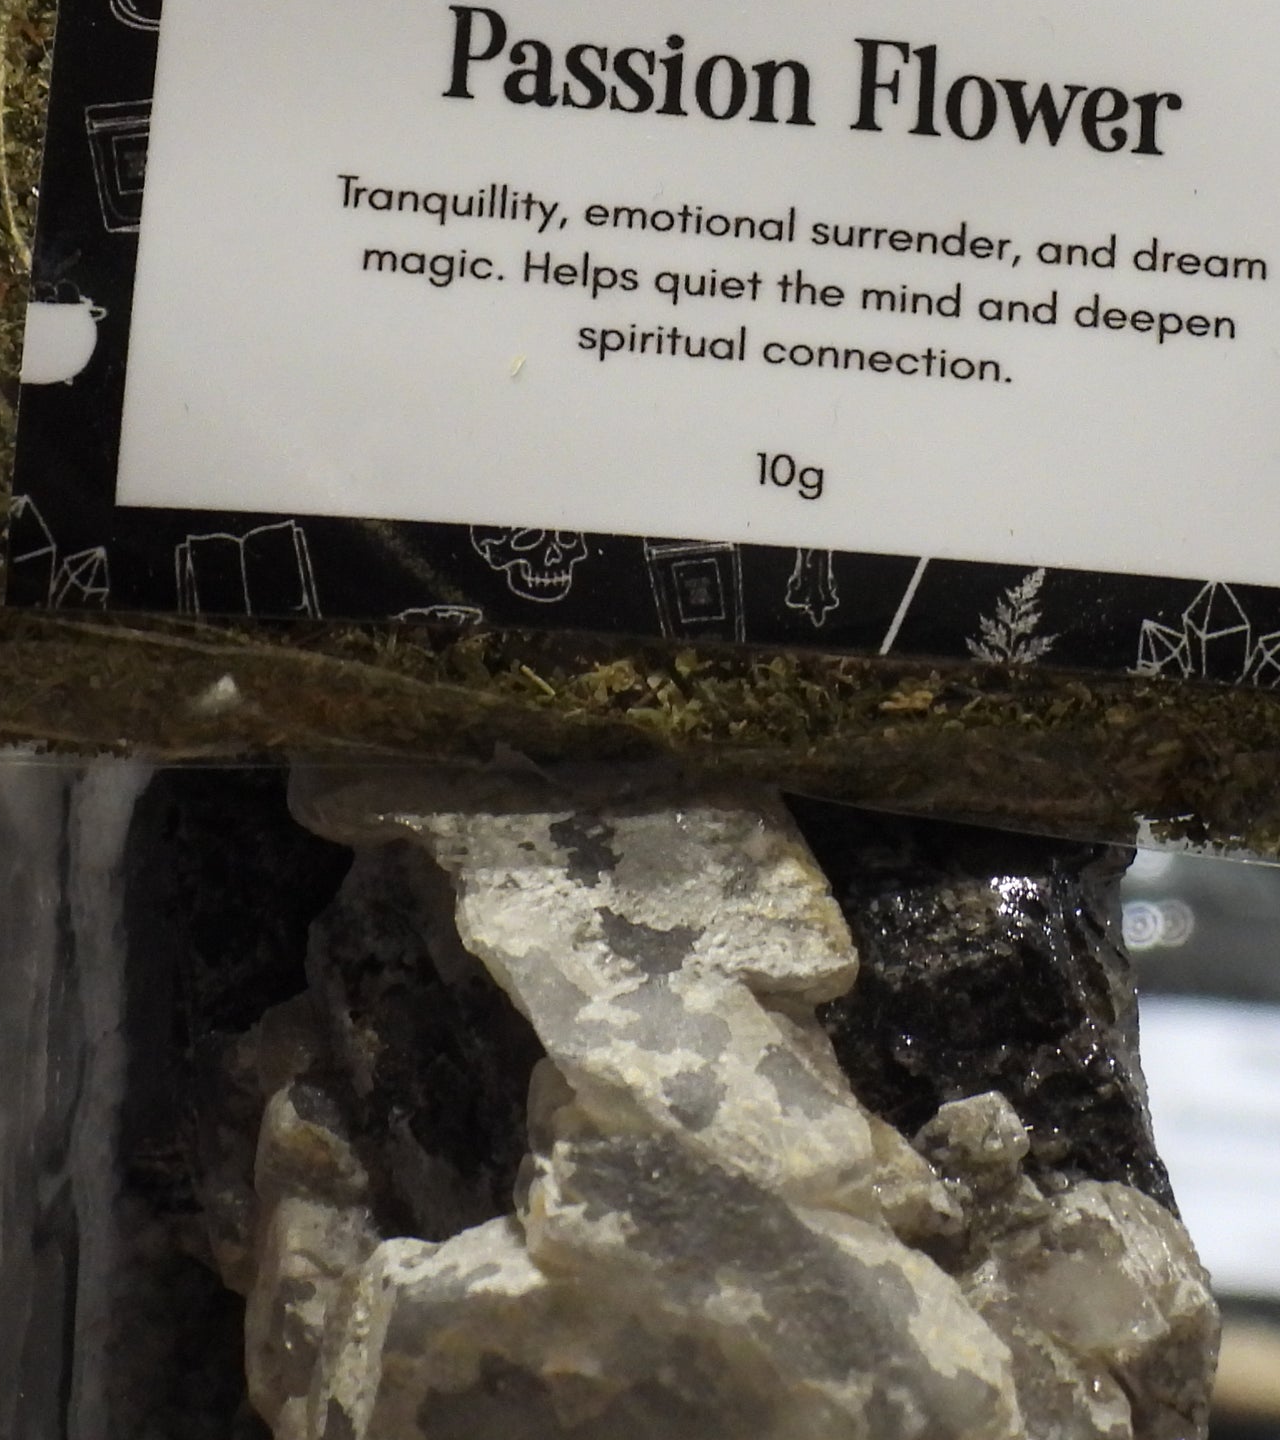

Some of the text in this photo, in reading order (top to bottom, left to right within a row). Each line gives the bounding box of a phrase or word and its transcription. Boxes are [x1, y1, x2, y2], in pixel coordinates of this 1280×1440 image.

[441, 3, 1184, 157] Passion Flower
[336, 173, 1268, 282] Tranquillity, emotional surrender, and dream
[361, 247, 1237, 346] magic. Helps quiet the mind and deepen
[577, 324, 1013, 385] spiritual connection.
[755, 451, 825, 502] 10g
